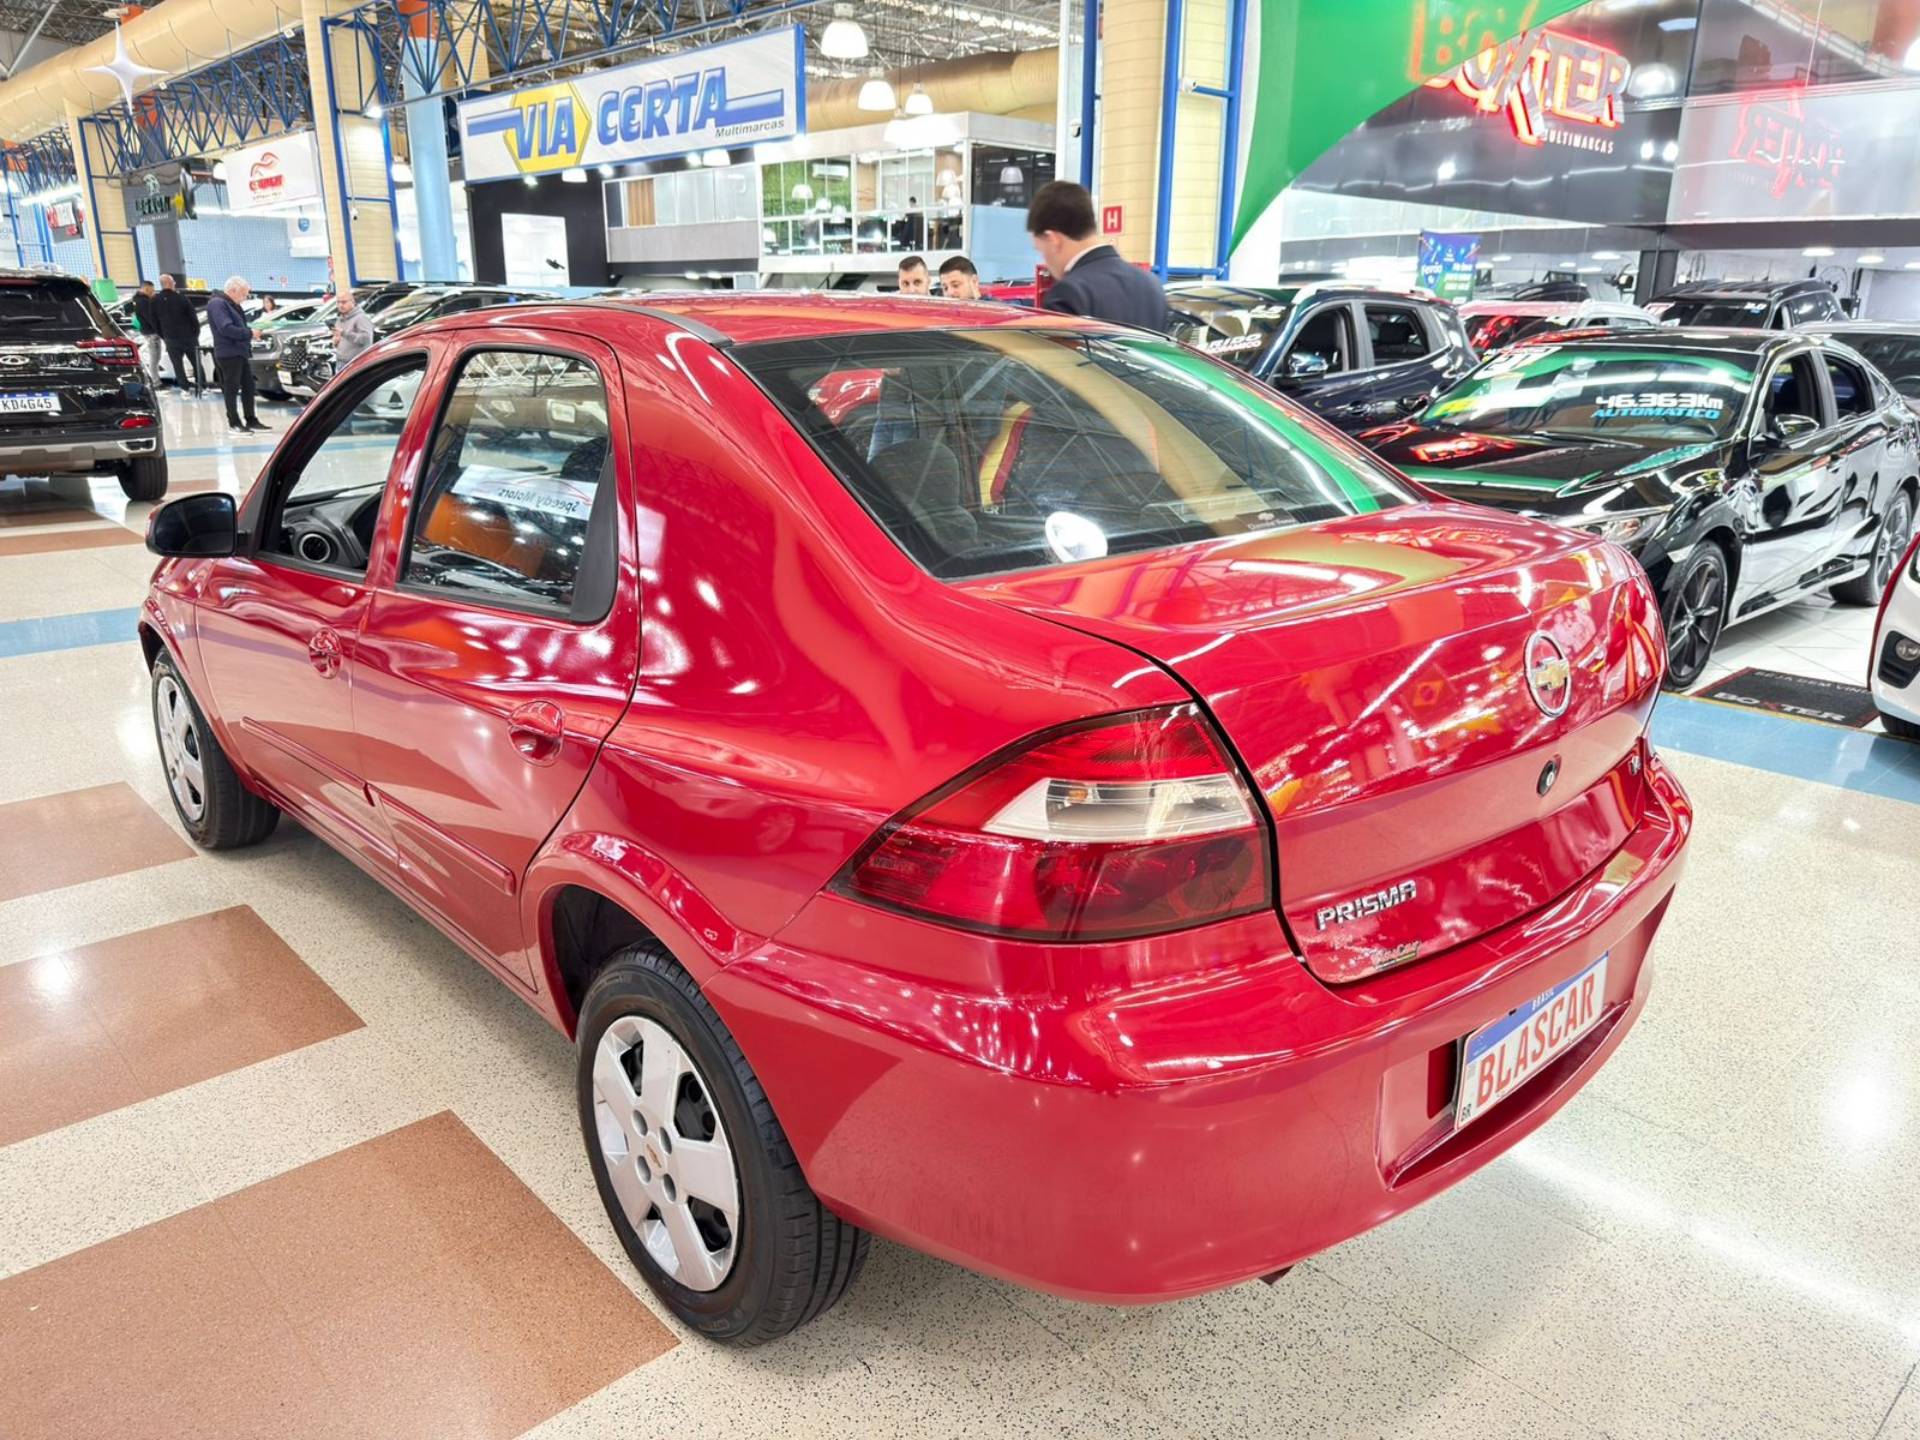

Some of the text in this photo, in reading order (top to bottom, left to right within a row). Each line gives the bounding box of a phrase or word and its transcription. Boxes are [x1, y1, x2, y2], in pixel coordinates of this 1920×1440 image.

[516, 66, 729, 160] VIA CERTA
[715, 118, 785, 139] Multimarcas
[1106, 209, 1119, 230] H
[0, 399, 52, 410] KD4G45
[1595, 393, 1724, 410] 46.363Km
[1316, 880, 1417, 930] PRISMA
[1477, 973, 1595, 1110] BLASCAR
